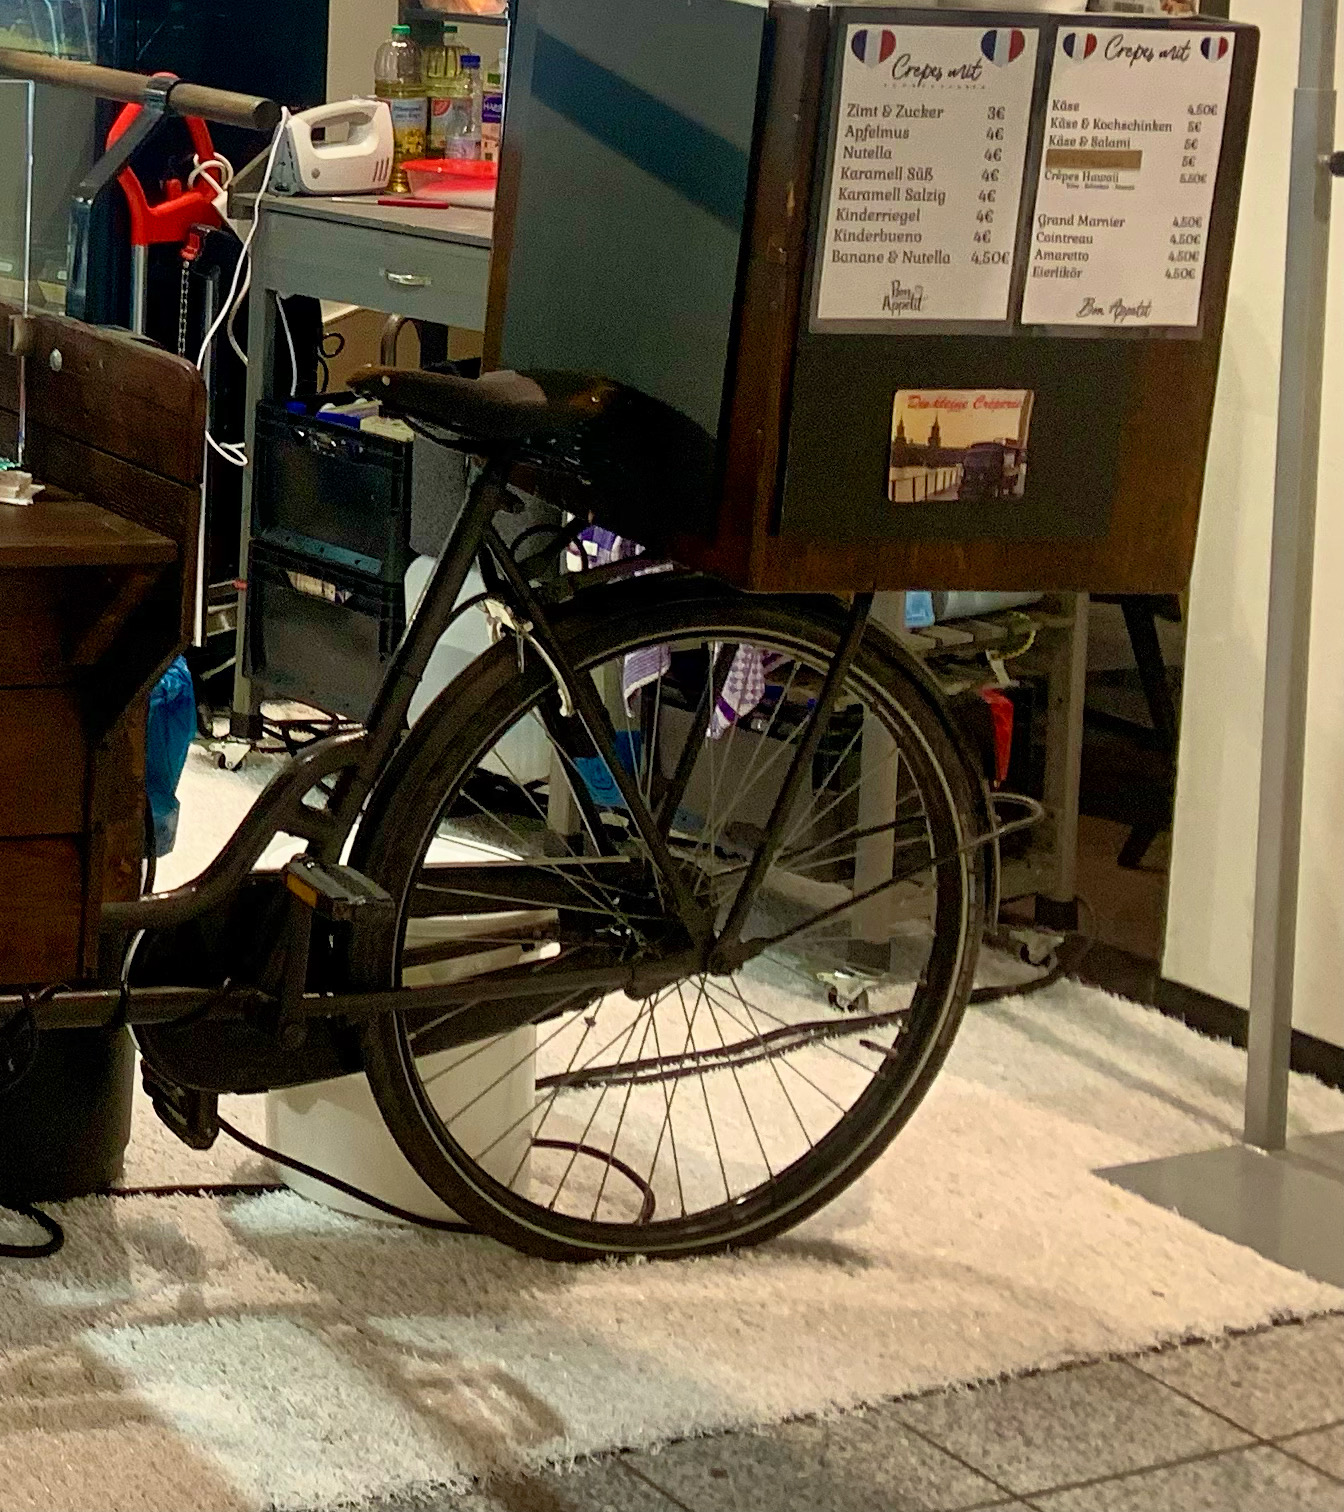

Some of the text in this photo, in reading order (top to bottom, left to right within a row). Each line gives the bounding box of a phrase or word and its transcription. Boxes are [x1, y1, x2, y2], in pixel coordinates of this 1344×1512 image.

[892, 53, 943, 87] Crepes
[847, 104, 1005, 120] Zimt & Zucker 3€
[845, 125, 1003, 142] Apfelmus 4€
[843, 146, 1002, 161] Nutella 4€
[841, 167, 999, 182] Karamell Süß 4€
[838, 187, 996, 205] Karamell Salzig 4€
[836, 208, 994, 225] Kinderriegel 4€
[834, 229, 991, 243] Kinderbueno 4€
[832, 249, 884, 263] Banane
[888, 250, 898, 264] &
[902, 250, 951, 264] Nutella
